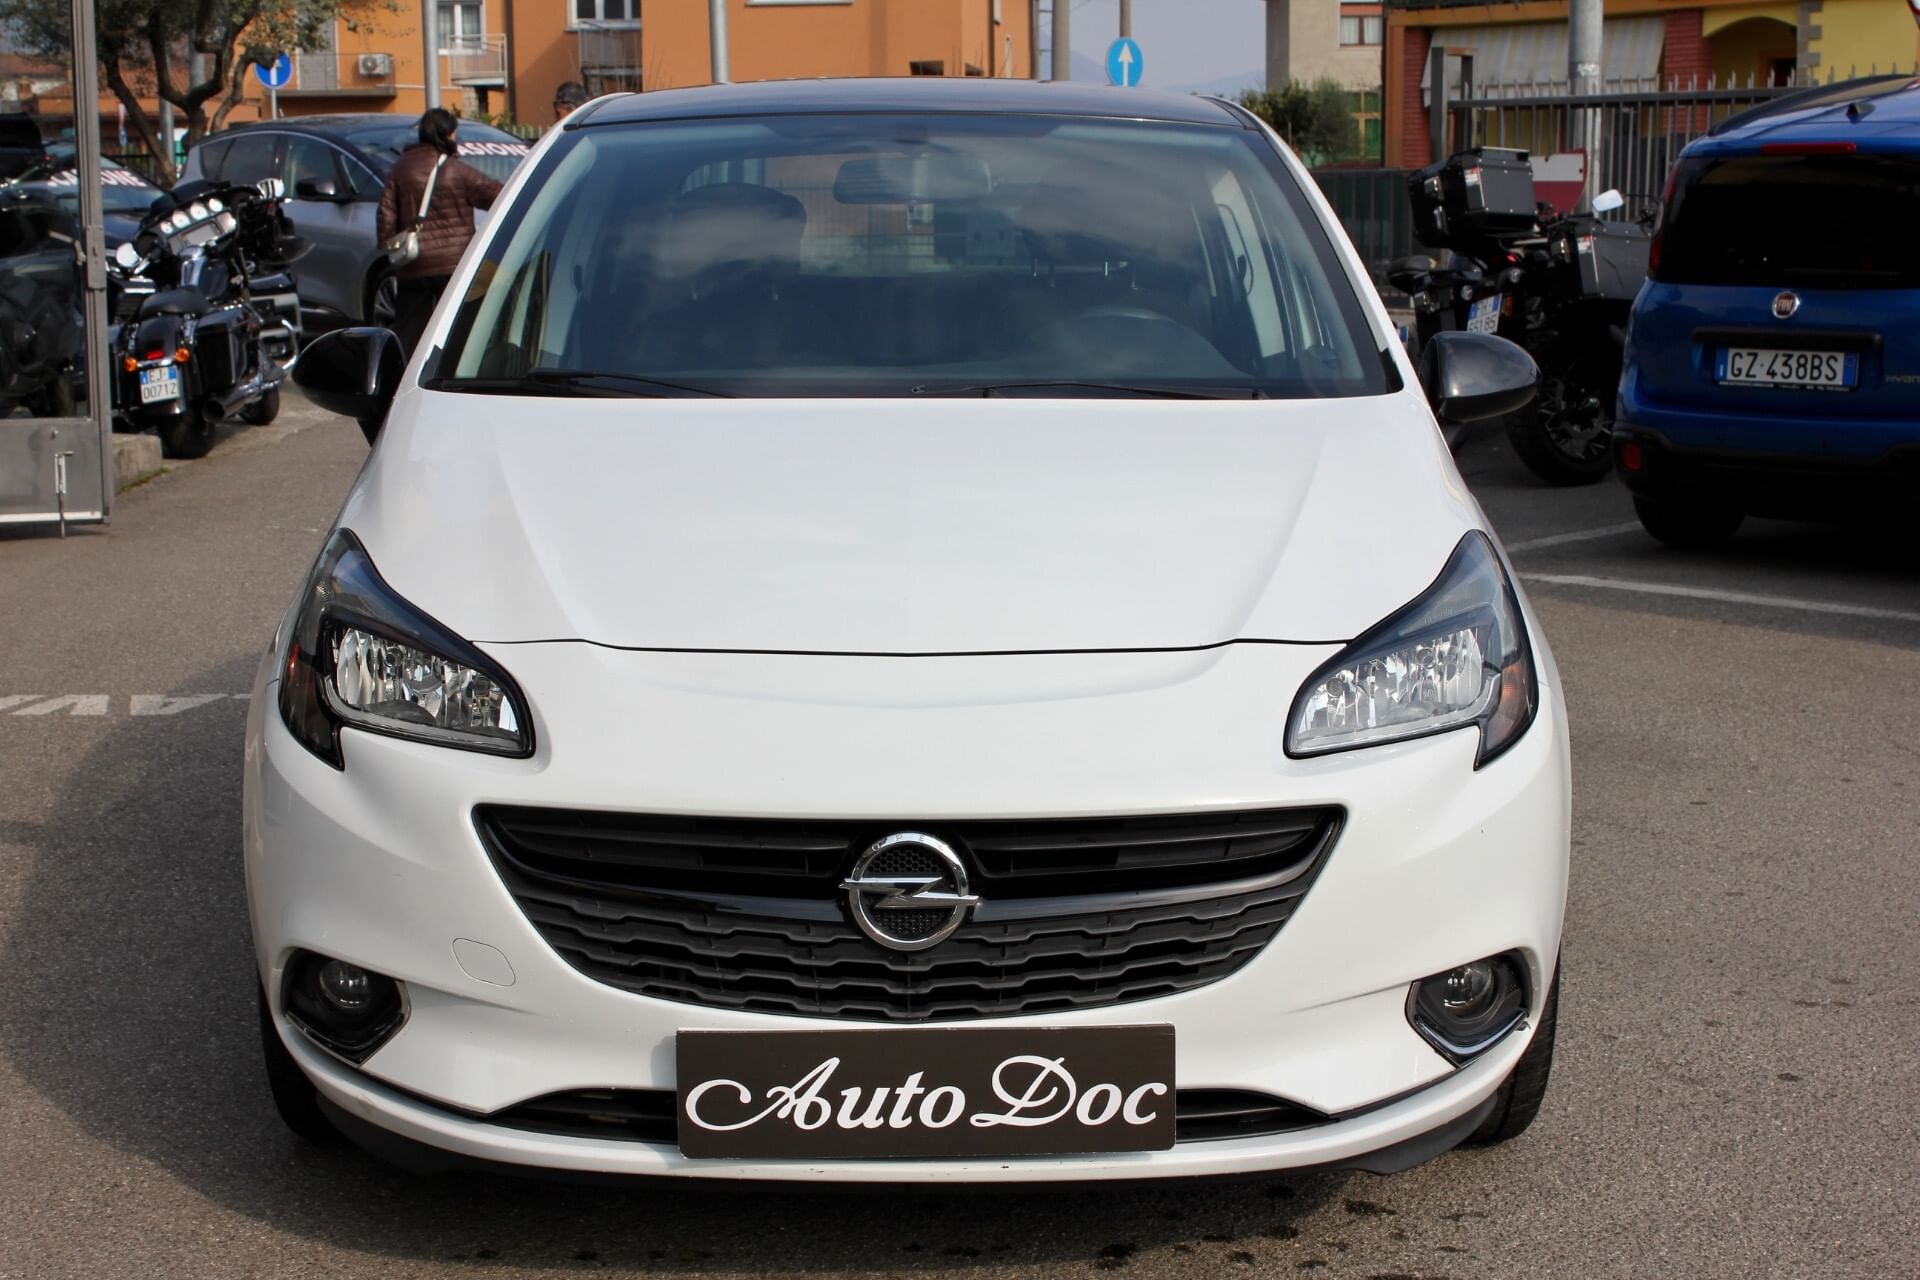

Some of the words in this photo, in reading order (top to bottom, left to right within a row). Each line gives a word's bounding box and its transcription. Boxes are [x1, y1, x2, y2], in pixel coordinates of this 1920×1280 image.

[143, 382, 177, 400] 00712
[685, 1056, 966, 1131] Auto
[969, 1054, 1168, 1128] Doc
